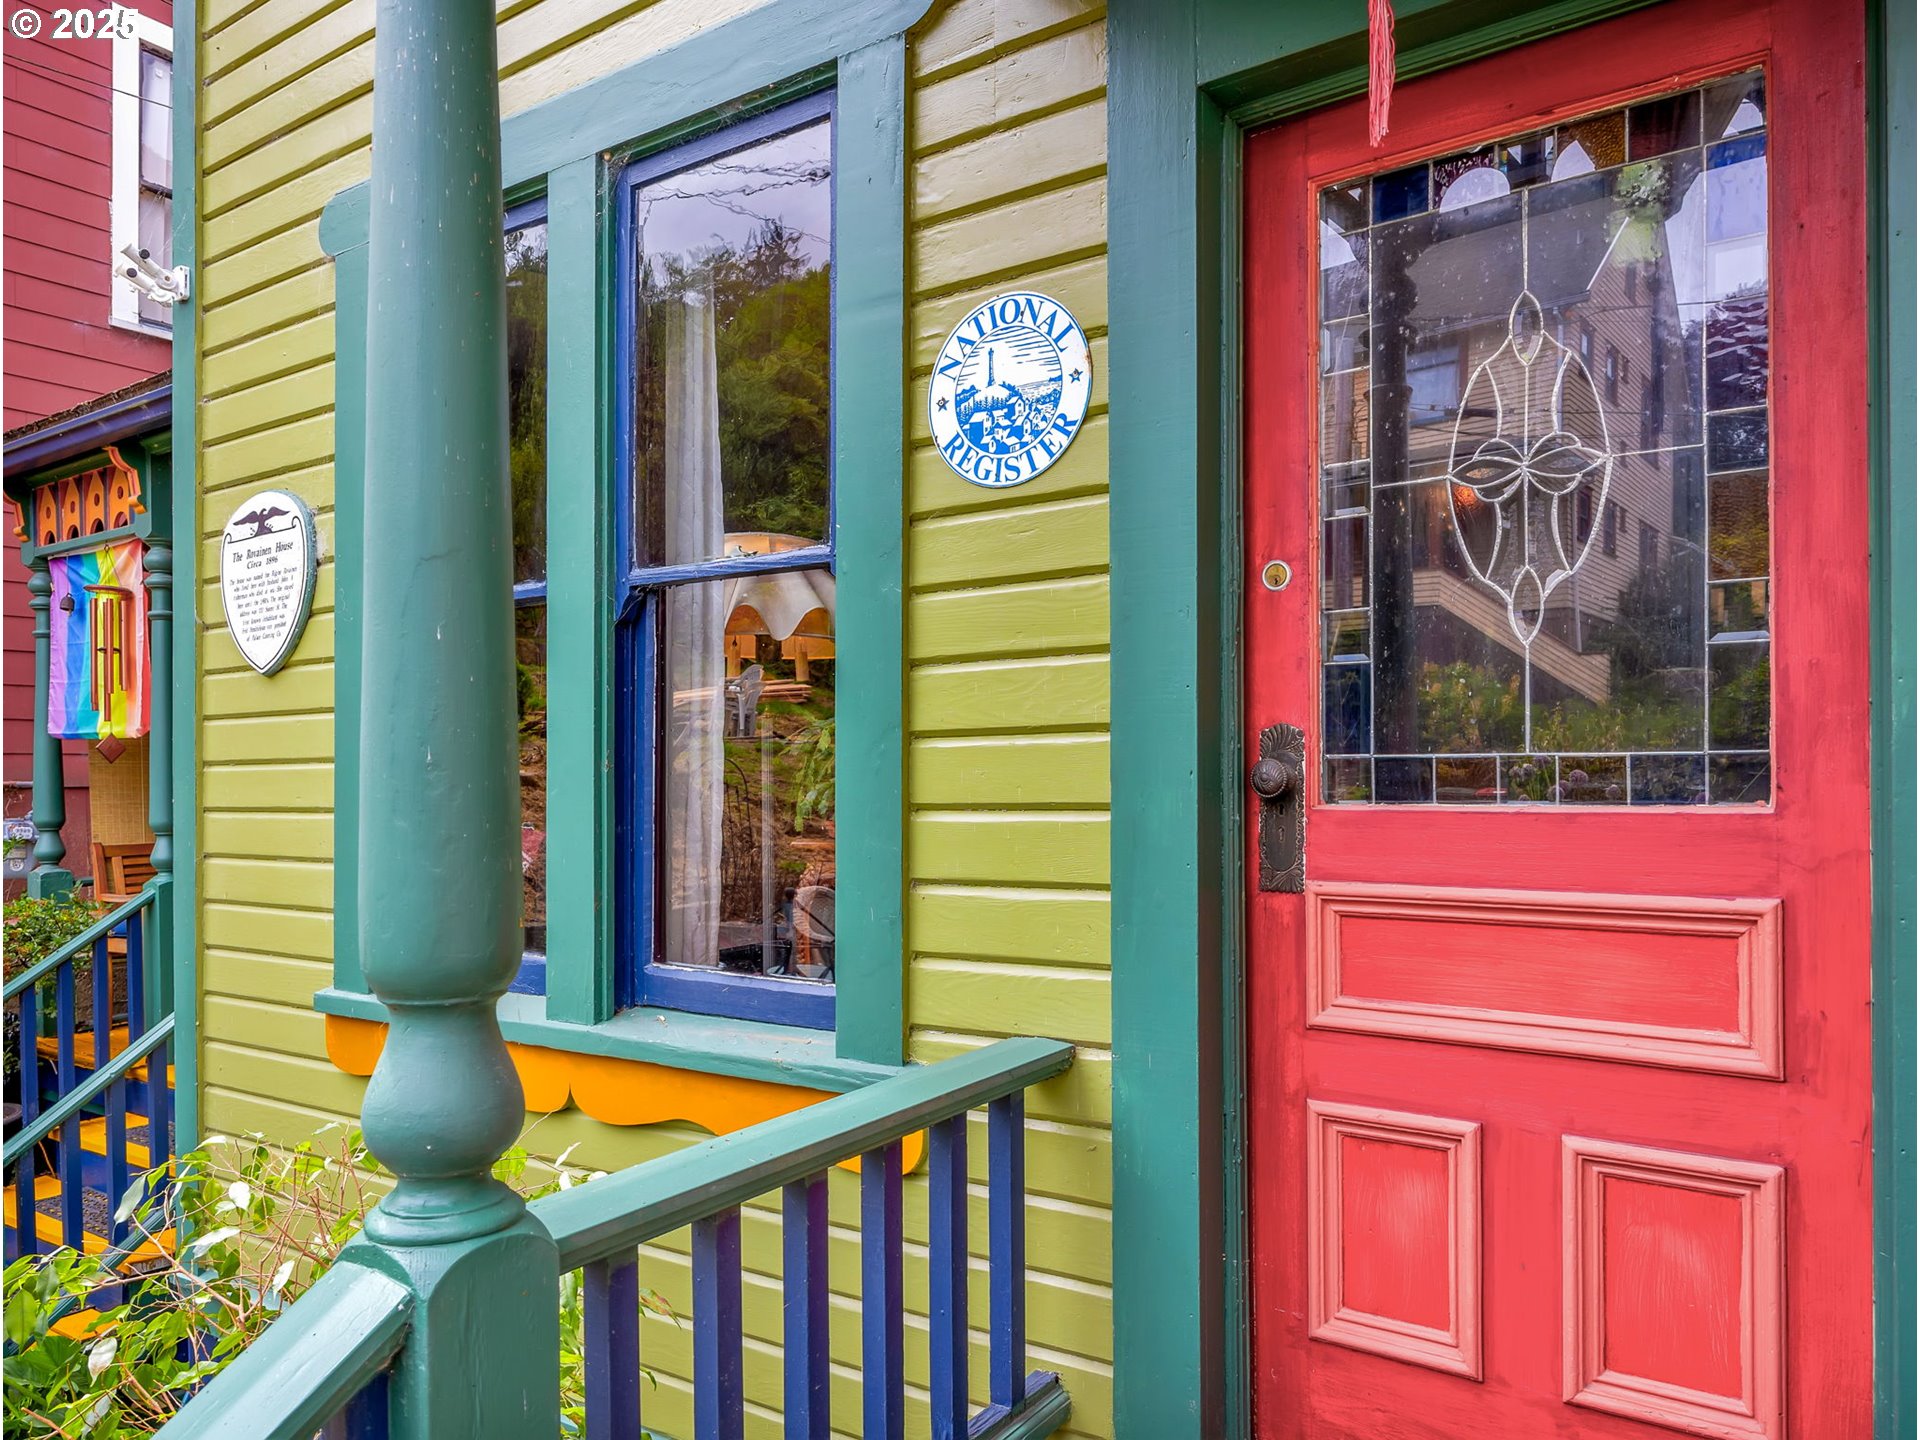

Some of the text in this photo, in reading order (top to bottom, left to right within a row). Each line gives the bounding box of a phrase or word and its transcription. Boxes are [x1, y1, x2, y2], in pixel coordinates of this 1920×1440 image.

[937, 297, 1076, 385] NATIONAL
[943, 412, 1078, 483] REGISTER
[232, 551, 243, 563] The
[275, 541, 294, 553] House
[246, 560, 262, 570] Circa
